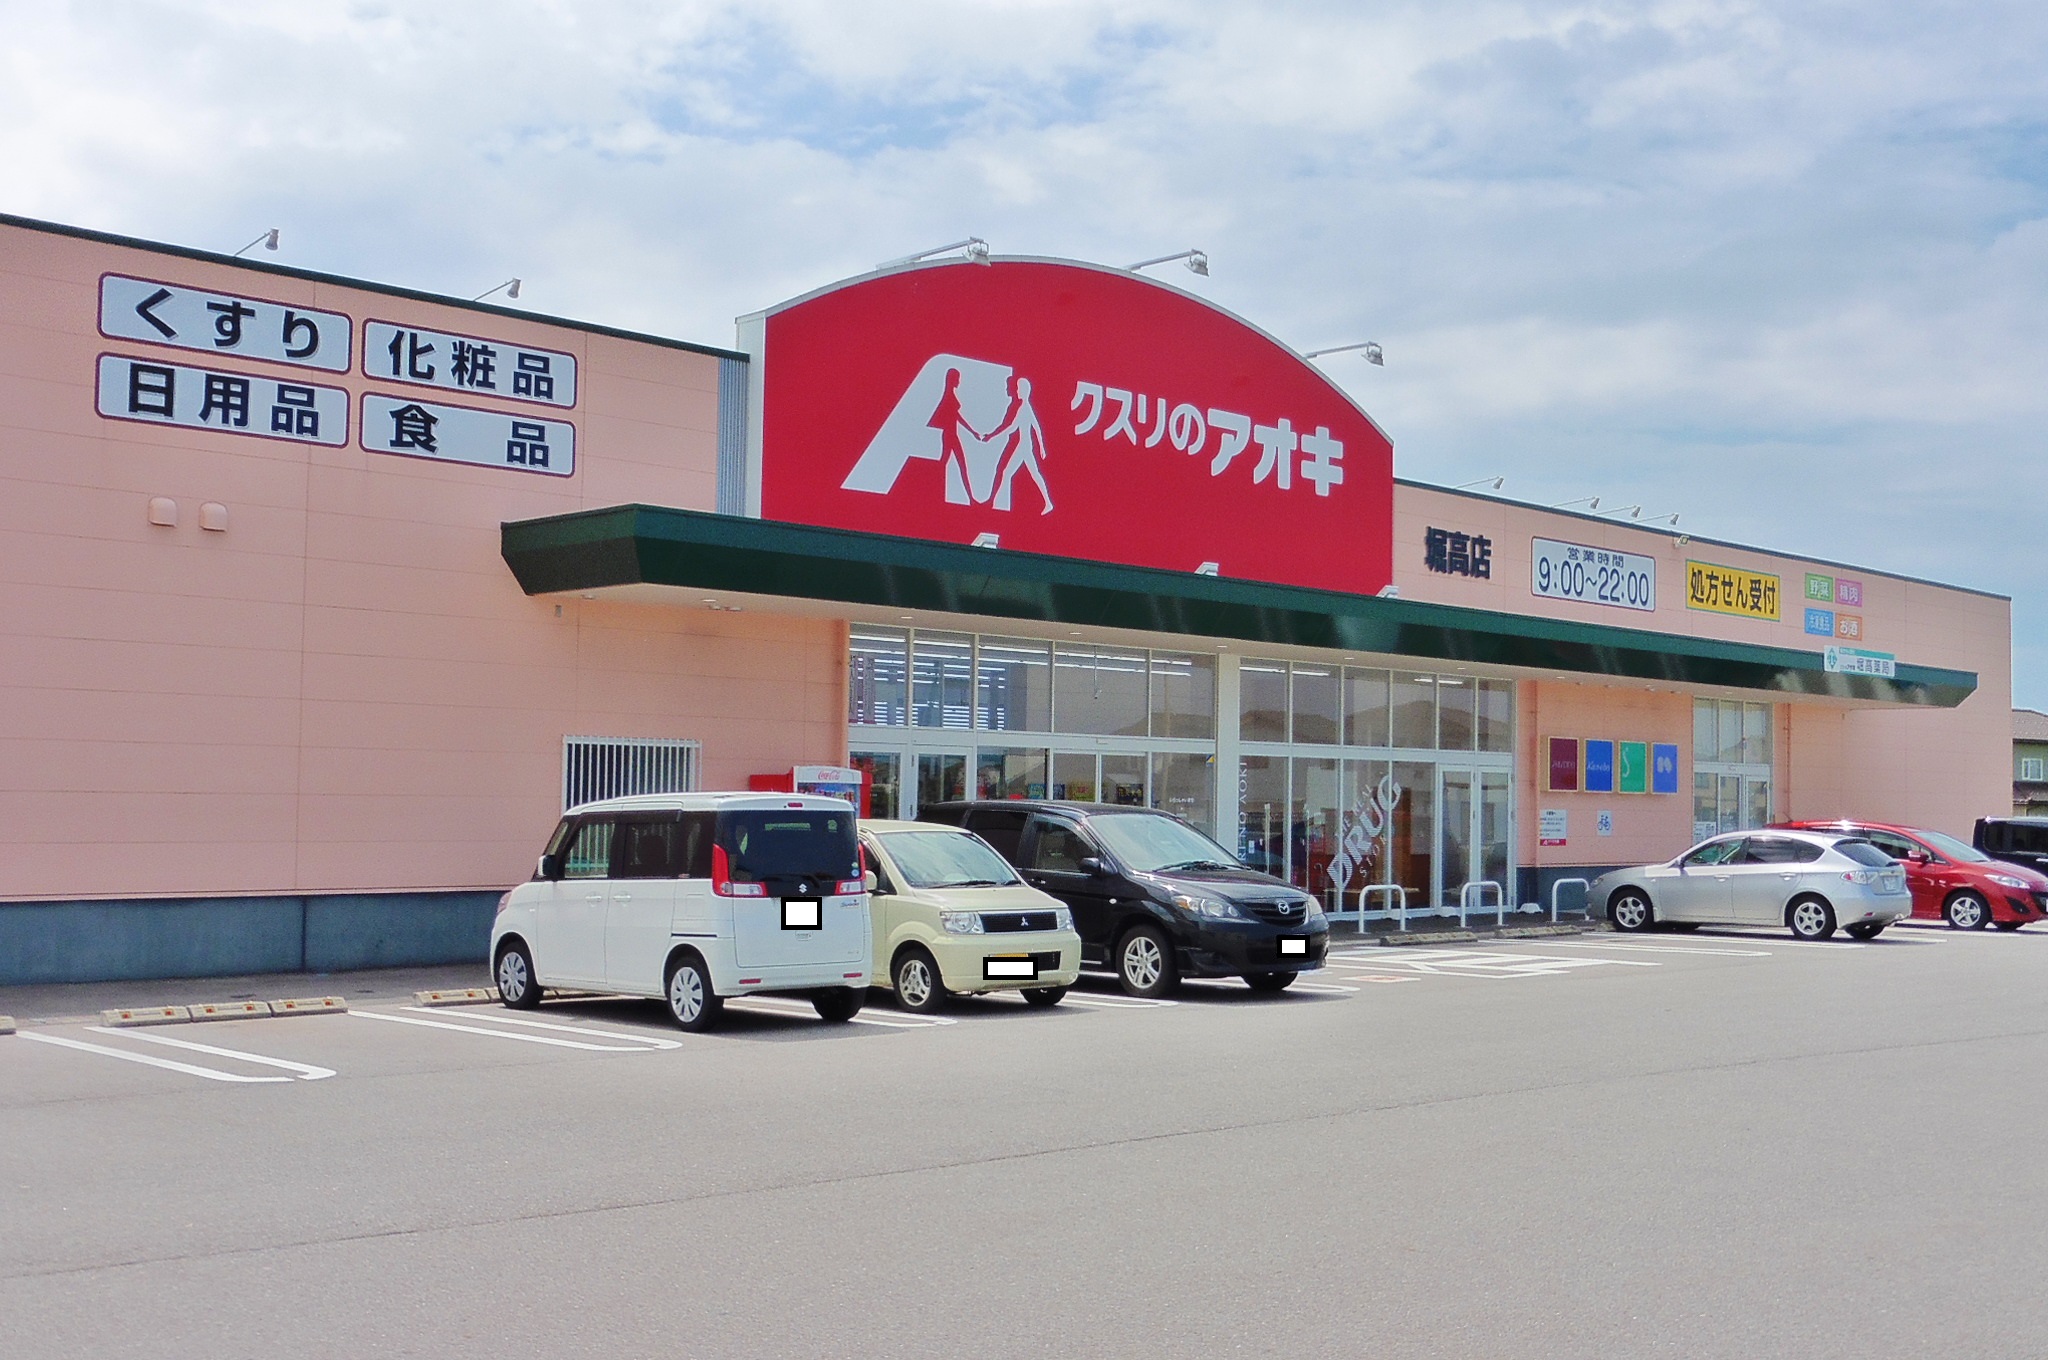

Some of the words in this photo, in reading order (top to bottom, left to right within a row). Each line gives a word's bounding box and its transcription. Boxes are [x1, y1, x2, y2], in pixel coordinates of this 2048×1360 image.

[135, 287, 320, 358] くすり
[388, 331, 555, 401] 化粧品
[127, 362, 319, 437] 日用品
[1071, 380, 1344, 497] クスリのアオキ
[1567, 547, 1624, 568] 営業時間
[1690, 567, 1776, 614] 処方せん受付
[1809, 579, 1829, 597] 野菜
[1839, 585, 1858, 602] 精肉
[1839, 620, 1858, 636] お酒
[1239, 762, 1248, 805] AOKI
[1327, 775, 1402, 892] DRUG
[1359, 834, 1389, 878] STOR
